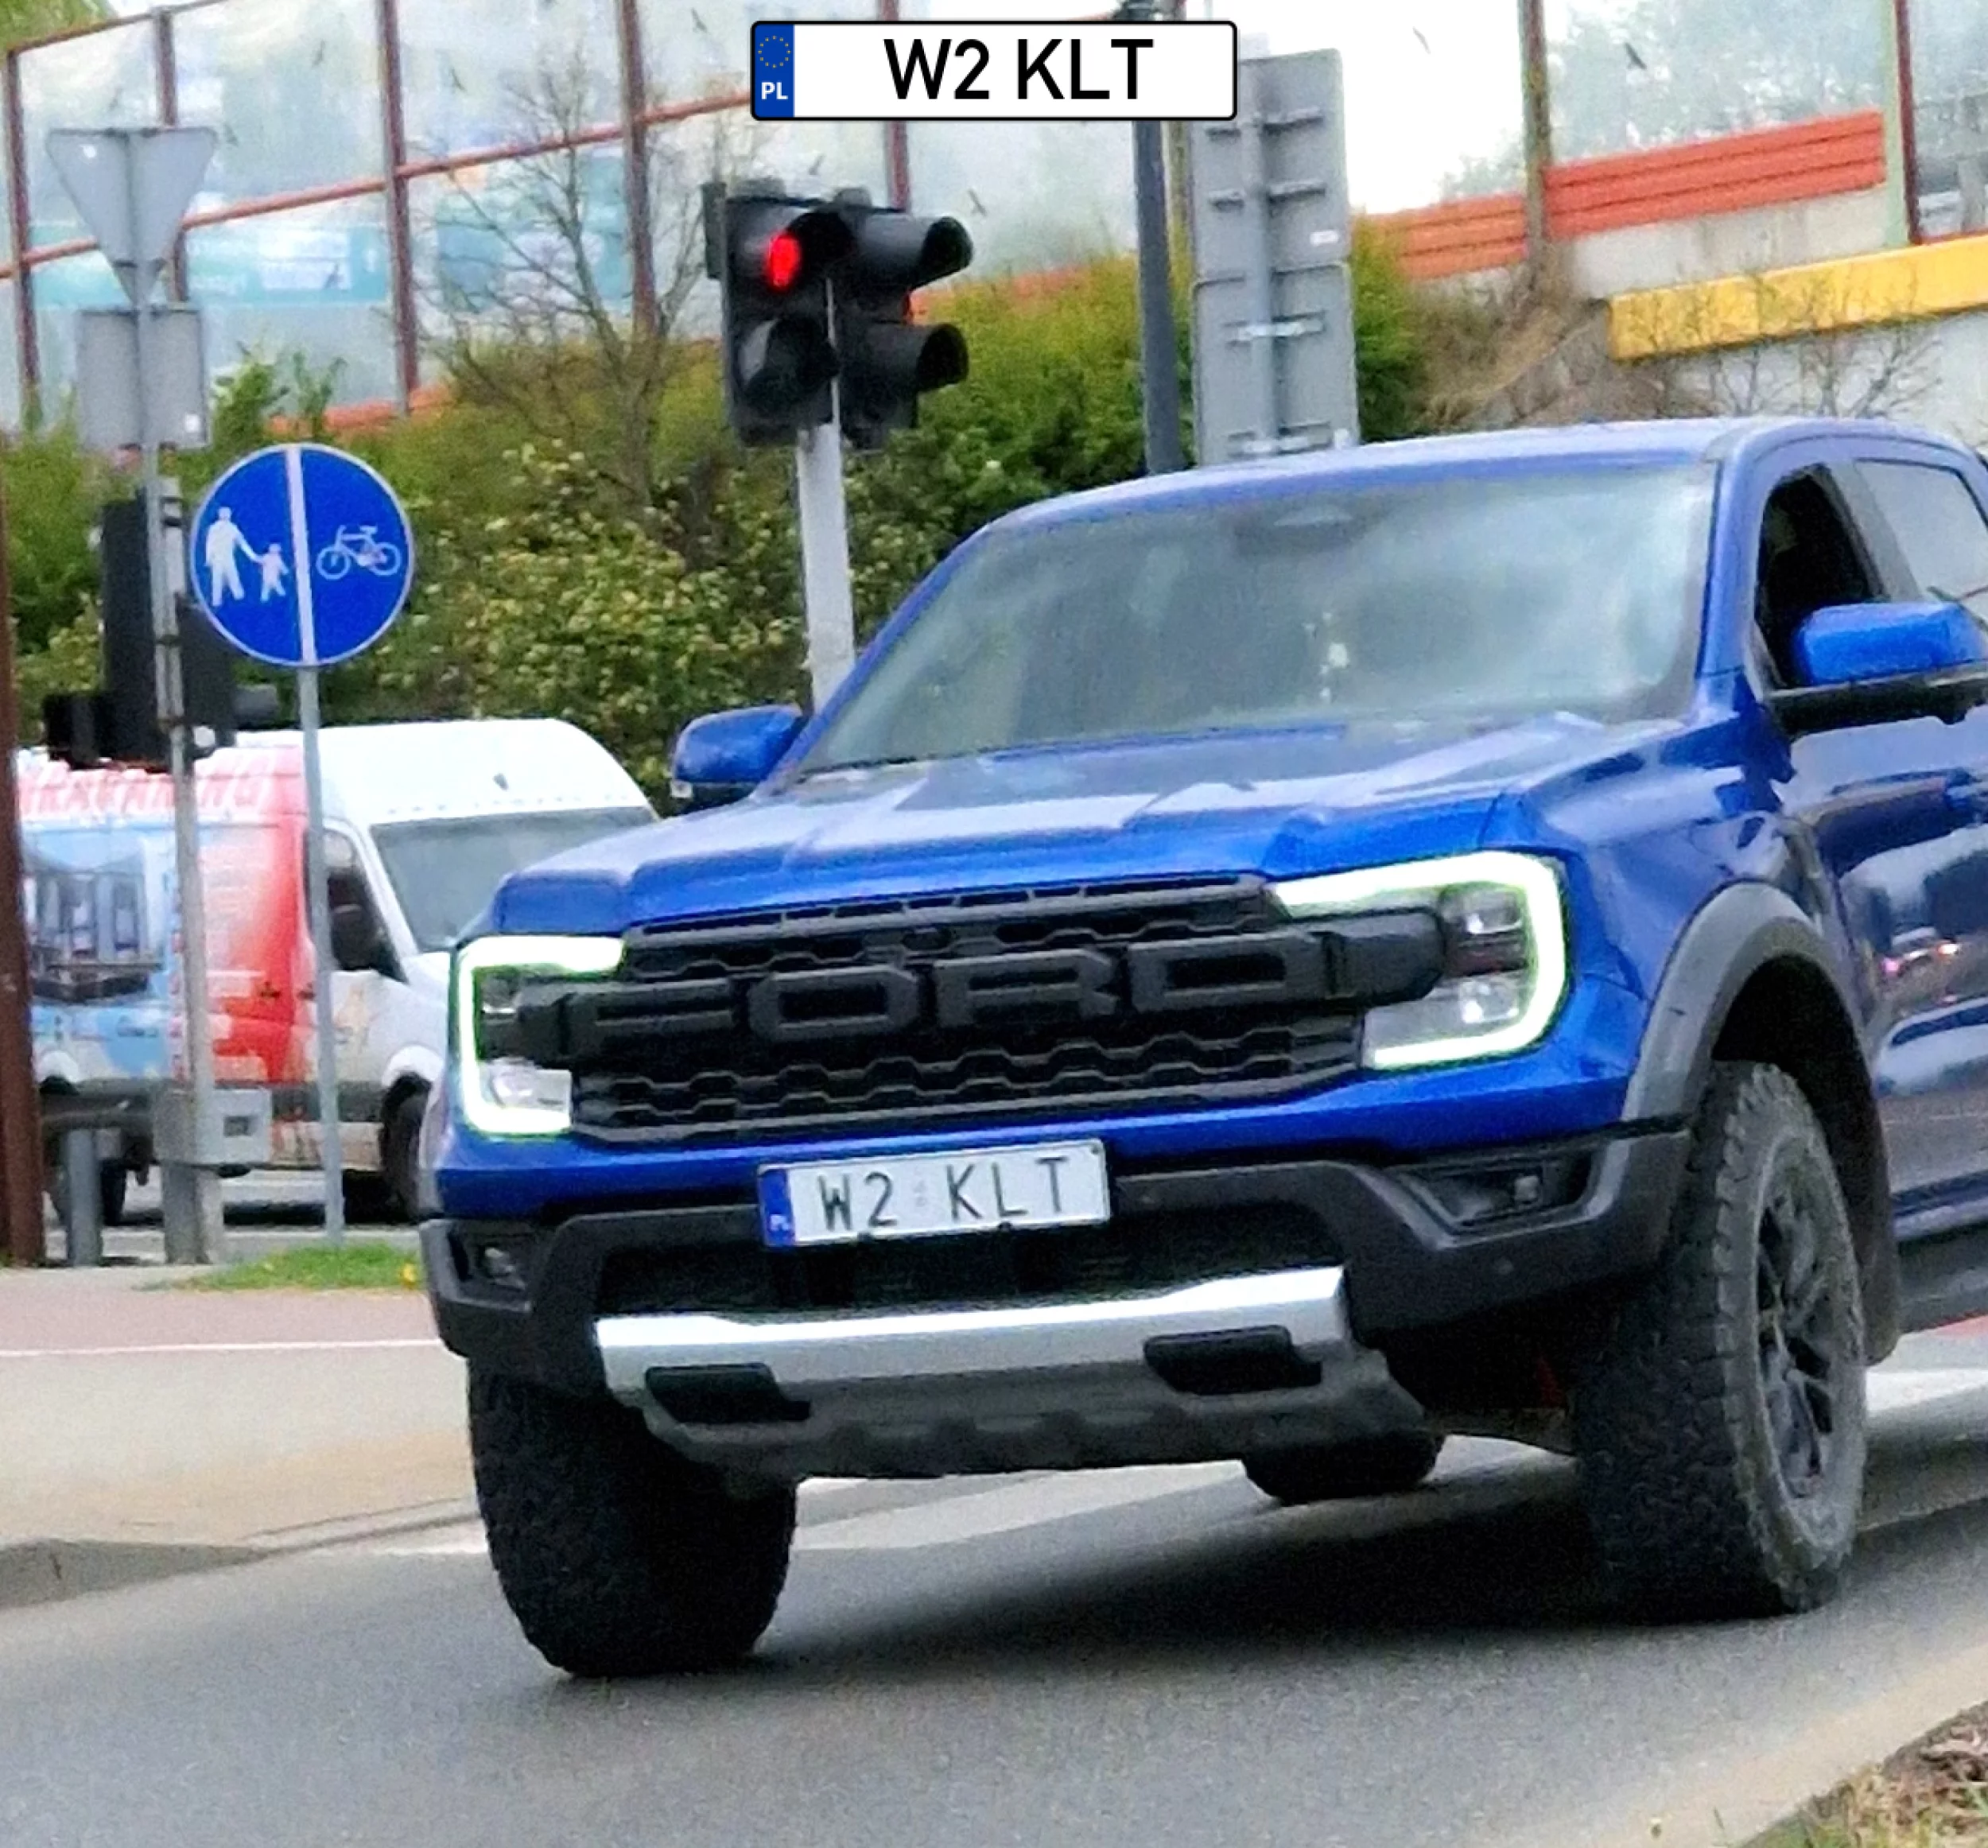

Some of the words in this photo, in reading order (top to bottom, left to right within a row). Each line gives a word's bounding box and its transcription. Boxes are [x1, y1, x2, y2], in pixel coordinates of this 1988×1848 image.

[568, 932, 1326, 1056] FORD
[818, 1172, 897, 1231] W2
[946, 1156, 1069, 1221] KLT
